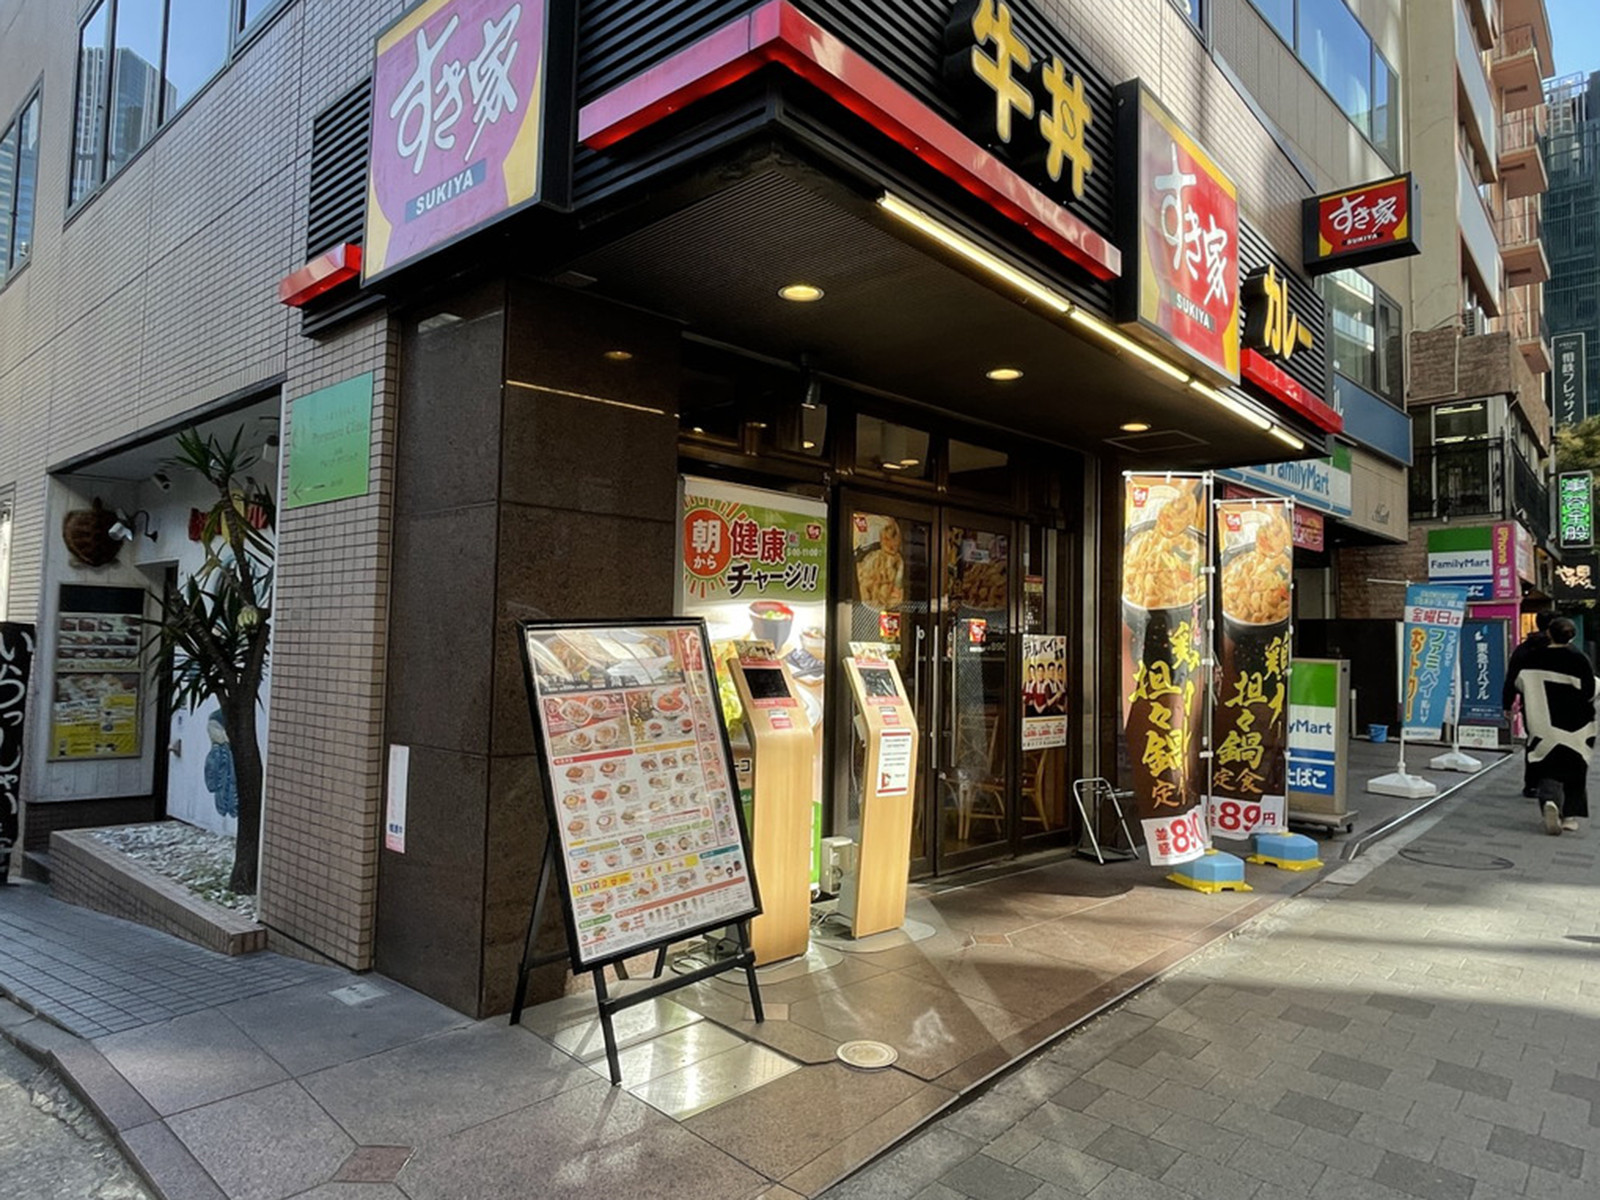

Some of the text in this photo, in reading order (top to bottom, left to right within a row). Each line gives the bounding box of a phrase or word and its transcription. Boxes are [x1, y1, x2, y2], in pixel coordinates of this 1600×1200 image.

[390, 3, 522, 175] すき家
[971, 0, 1093, 199] 牛丼
[415, 168, 474, 215] SUKIYA
[1154, 141, 1229, 307] すき家
[1328, 195, 1398, 235] すき家
[1346, 233, 1379, 246] SUKIYA
[1175, 293, 1212, 330] SUKIYA
[1263, 262, 1313, 361] カレー
[691, 519, 722, 555] 朝
[730, 519, 787, 564] 健康
[693, 555, 718, 569] から
[1430, 558, 1490, 569] FamilyMart
[1213, 768, 1266, 794] 定食
